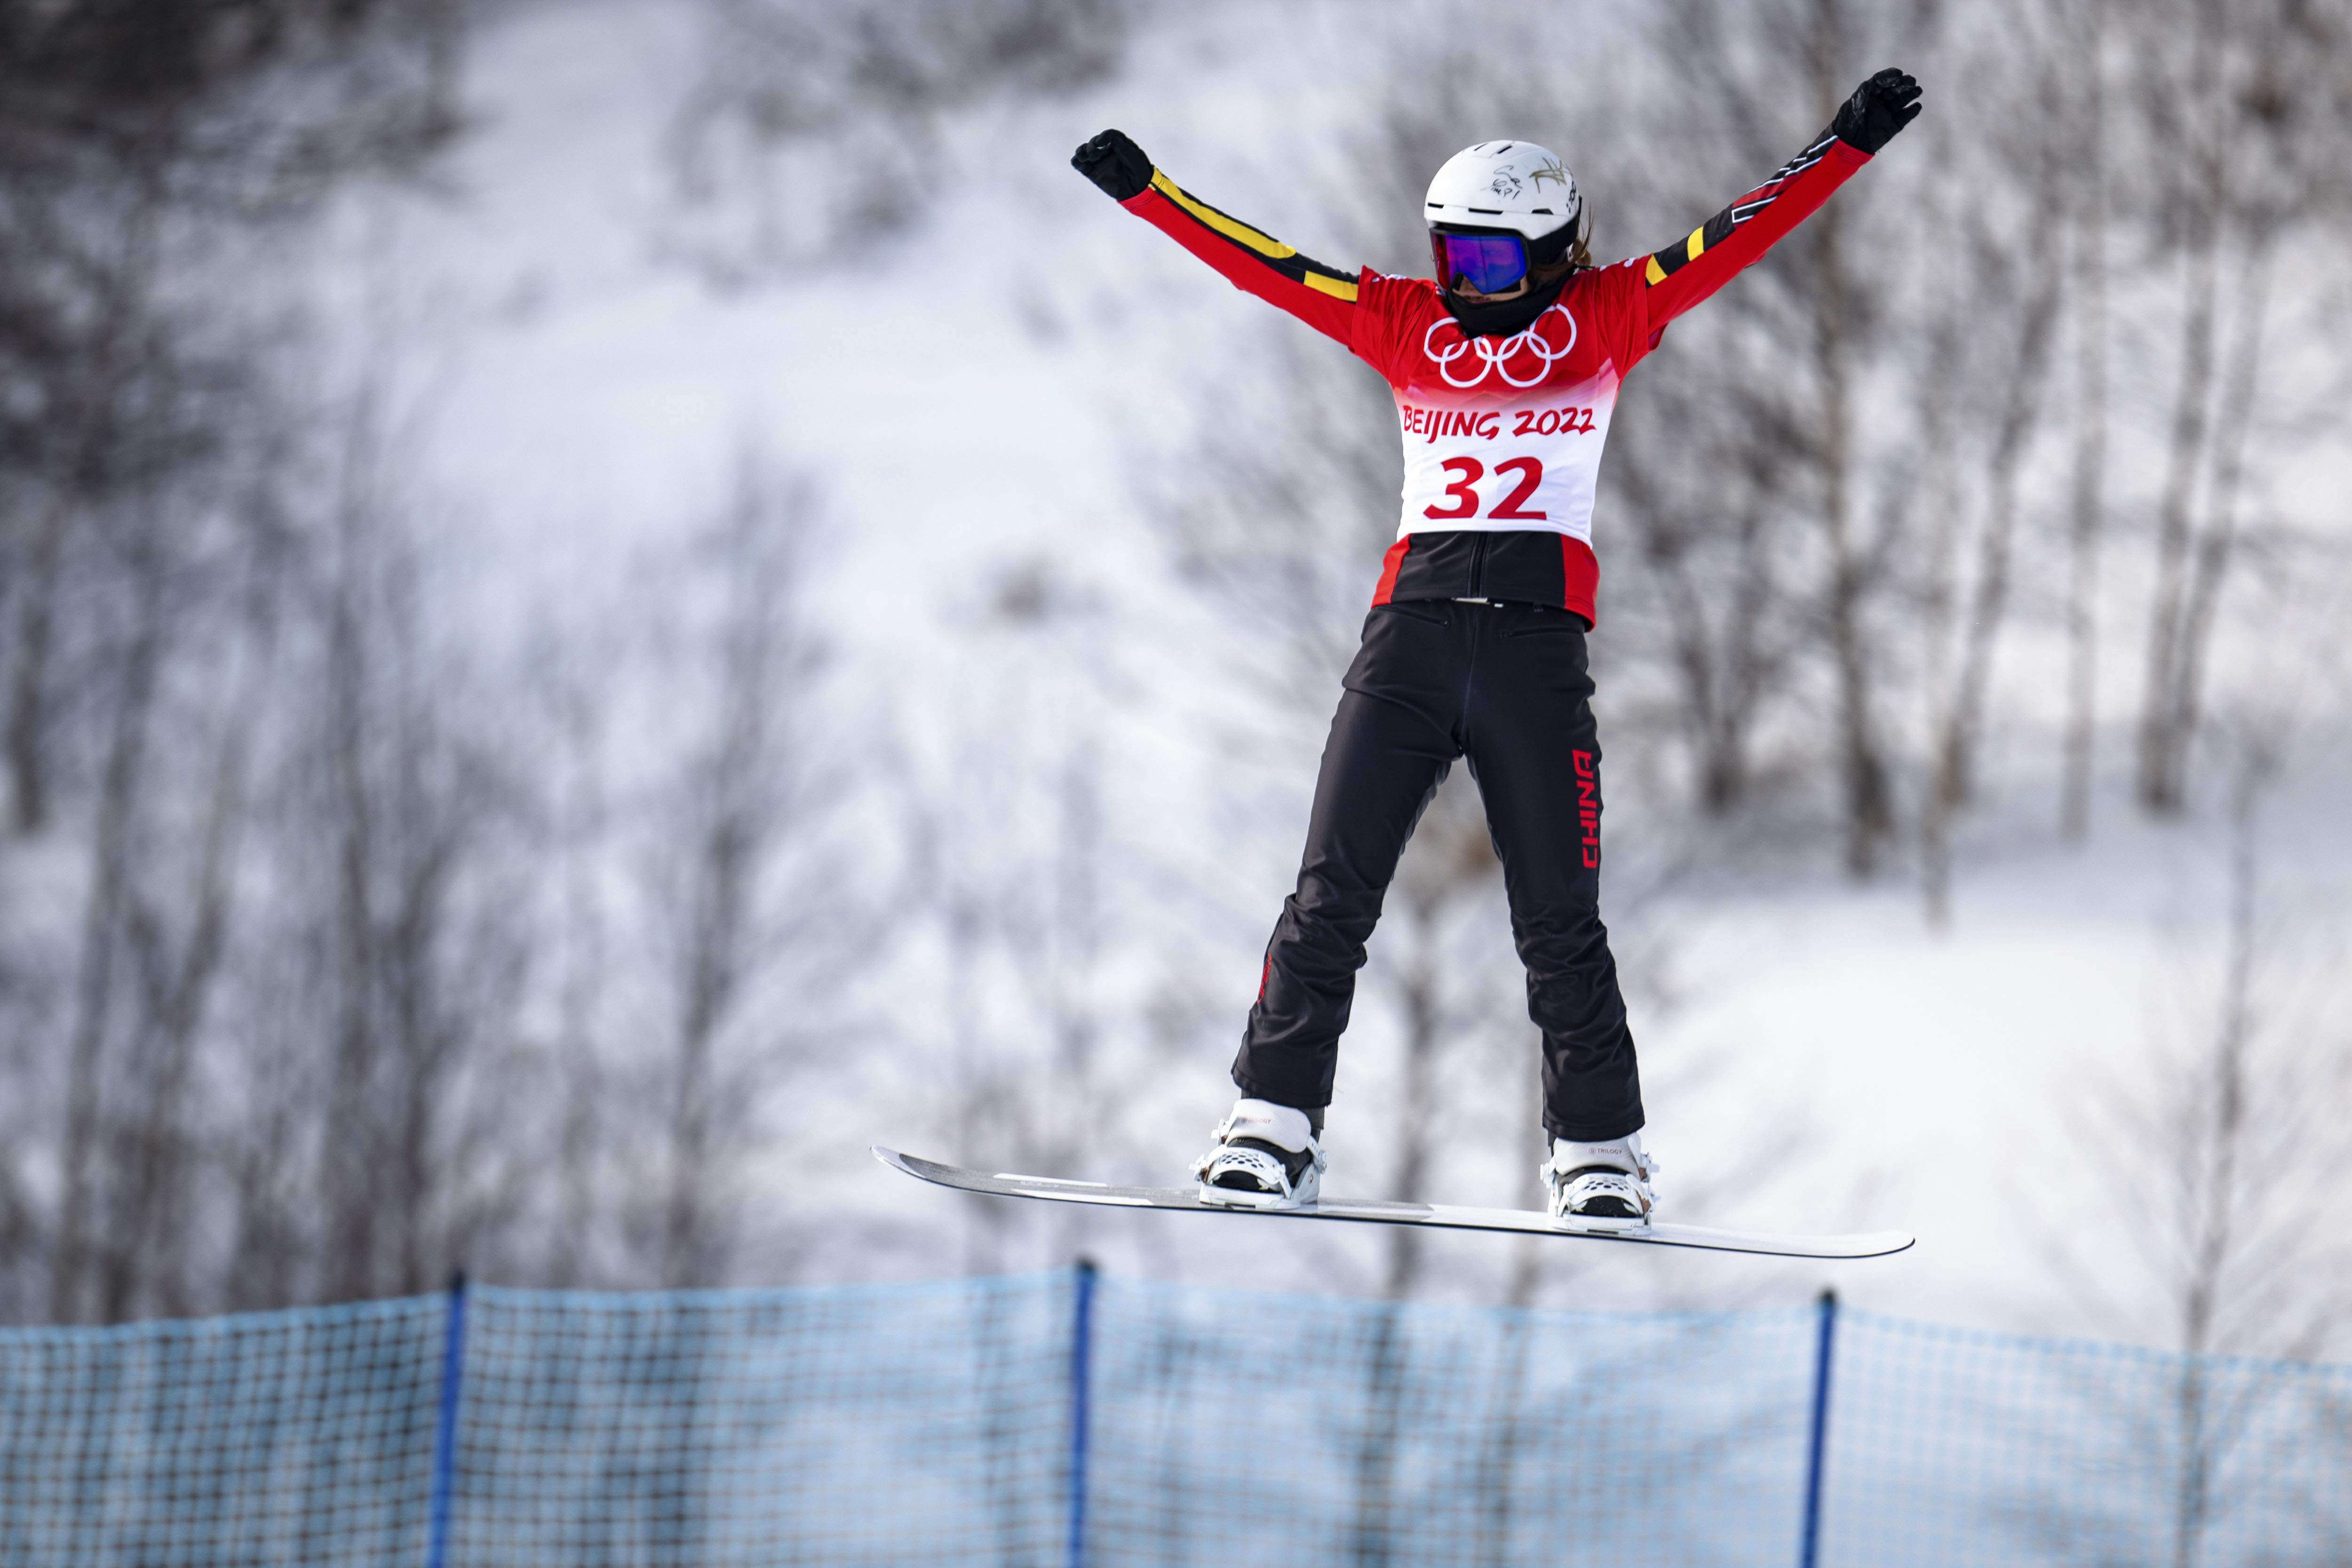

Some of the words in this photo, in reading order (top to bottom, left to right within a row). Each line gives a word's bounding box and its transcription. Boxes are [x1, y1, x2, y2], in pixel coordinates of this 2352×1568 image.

[1403, 405, 1501, 444] BEIJING
[1512, 407, 1597, 437] 2022
[1423, 456, 1547, 520] 32
[1572, 749, 1598, 869] CHINA
